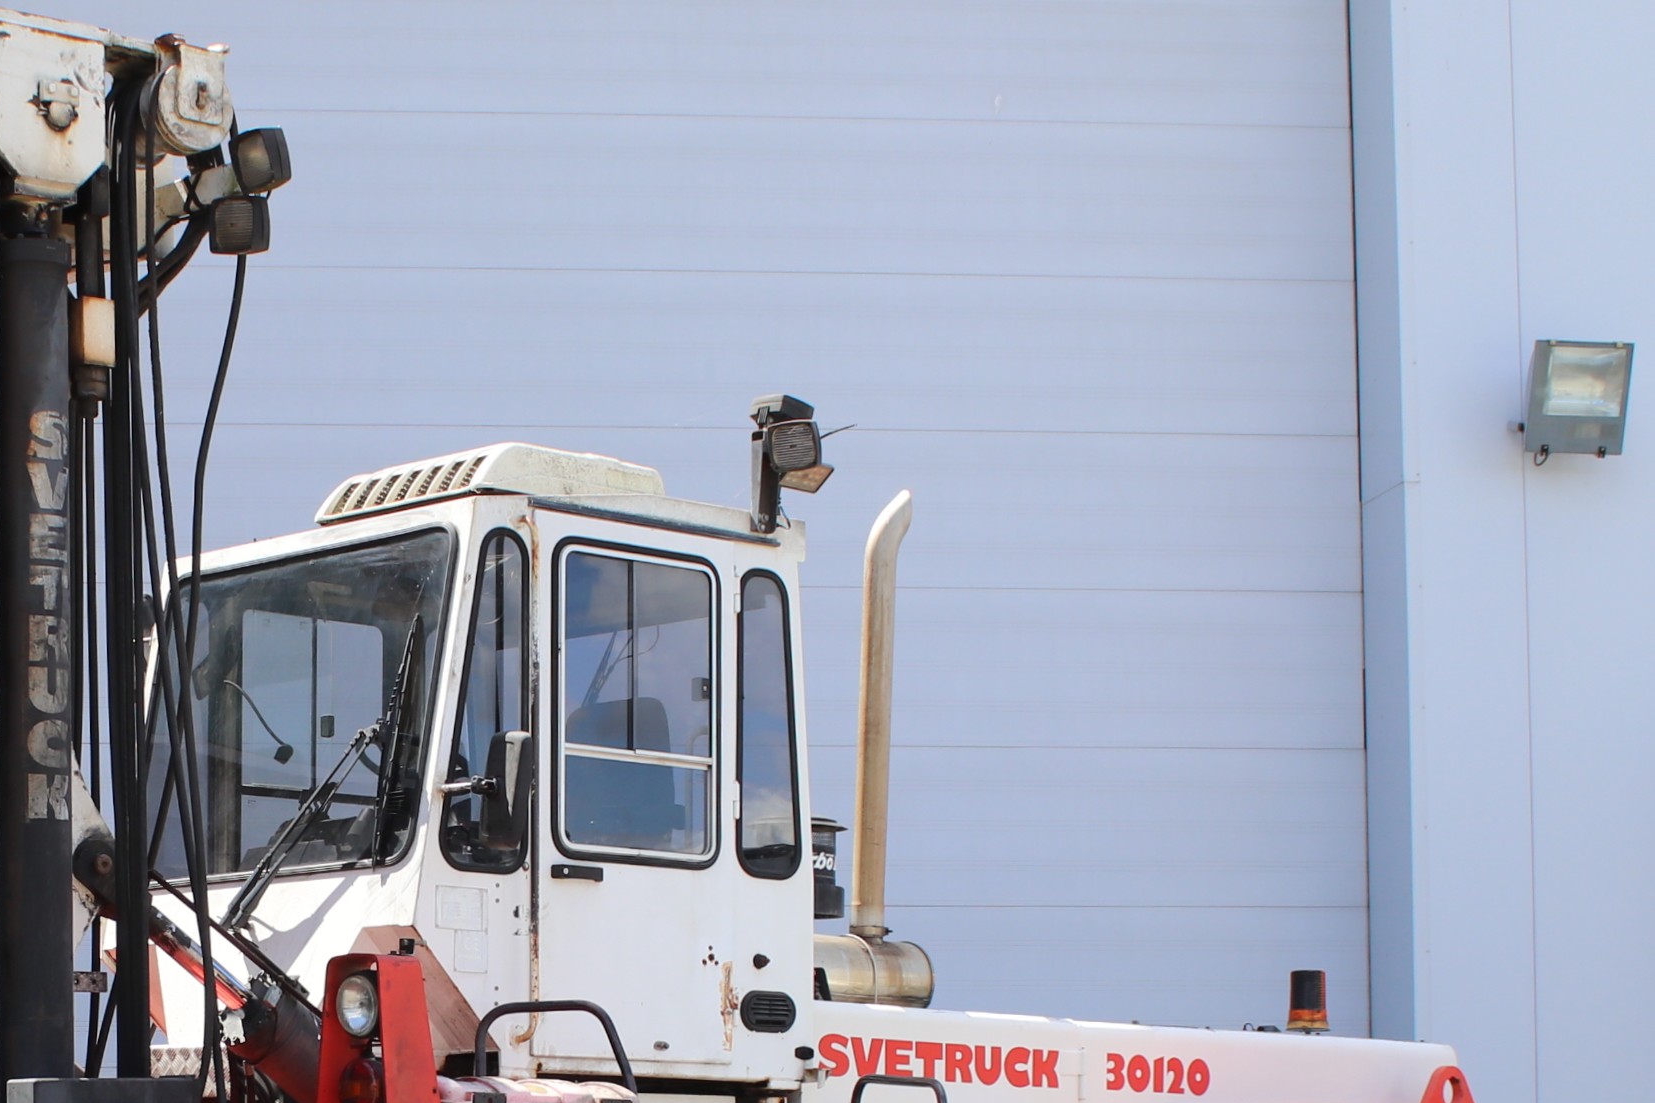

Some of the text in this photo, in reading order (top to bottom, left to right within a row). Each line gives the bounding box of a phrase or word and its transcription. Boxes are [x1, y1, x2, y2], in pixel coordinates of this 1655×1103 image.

[26, 409, 70, 822] SVETRUCK
[818, 1033, 1210, 1096] SVETRUCK 30120
